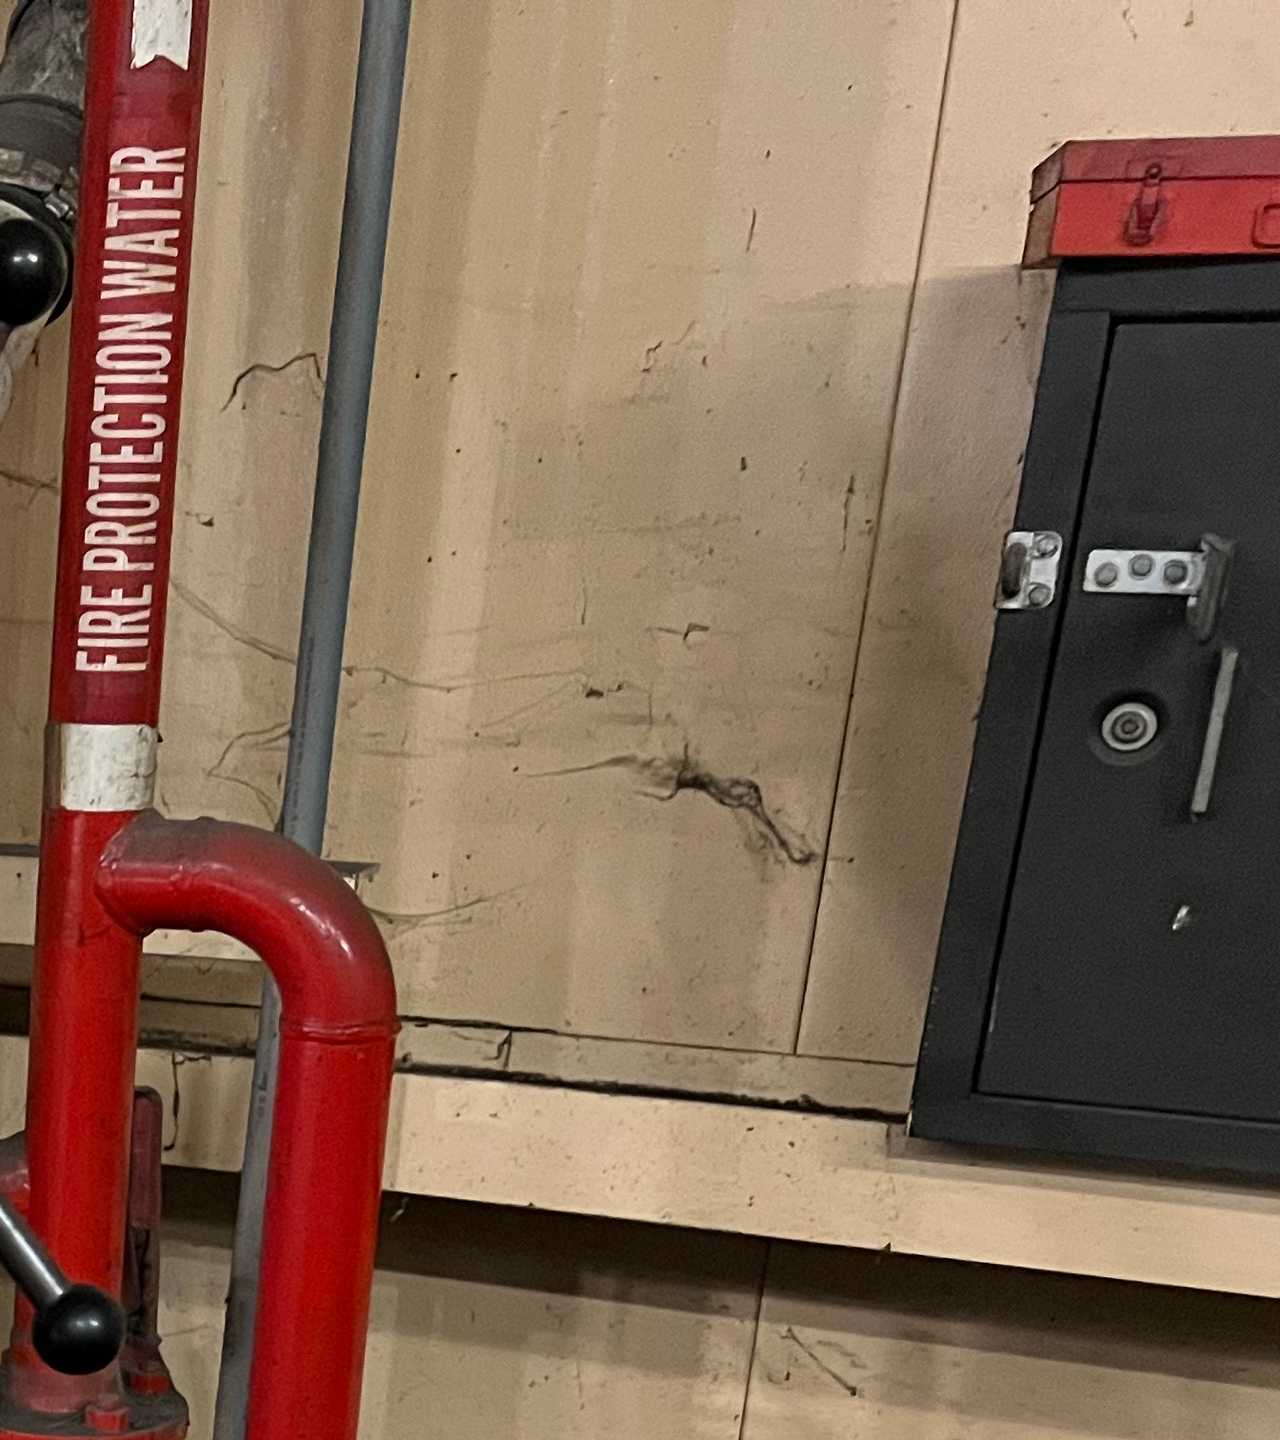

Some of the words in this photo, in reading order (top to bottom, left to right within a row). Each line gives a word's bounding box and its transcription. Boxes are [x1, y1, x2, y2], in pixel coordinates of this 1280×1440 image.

[100, 146, 186, 300] WATER
[82, 313, 173, 571] PROTECTION
[76, 584, 153, 671] FIRE
